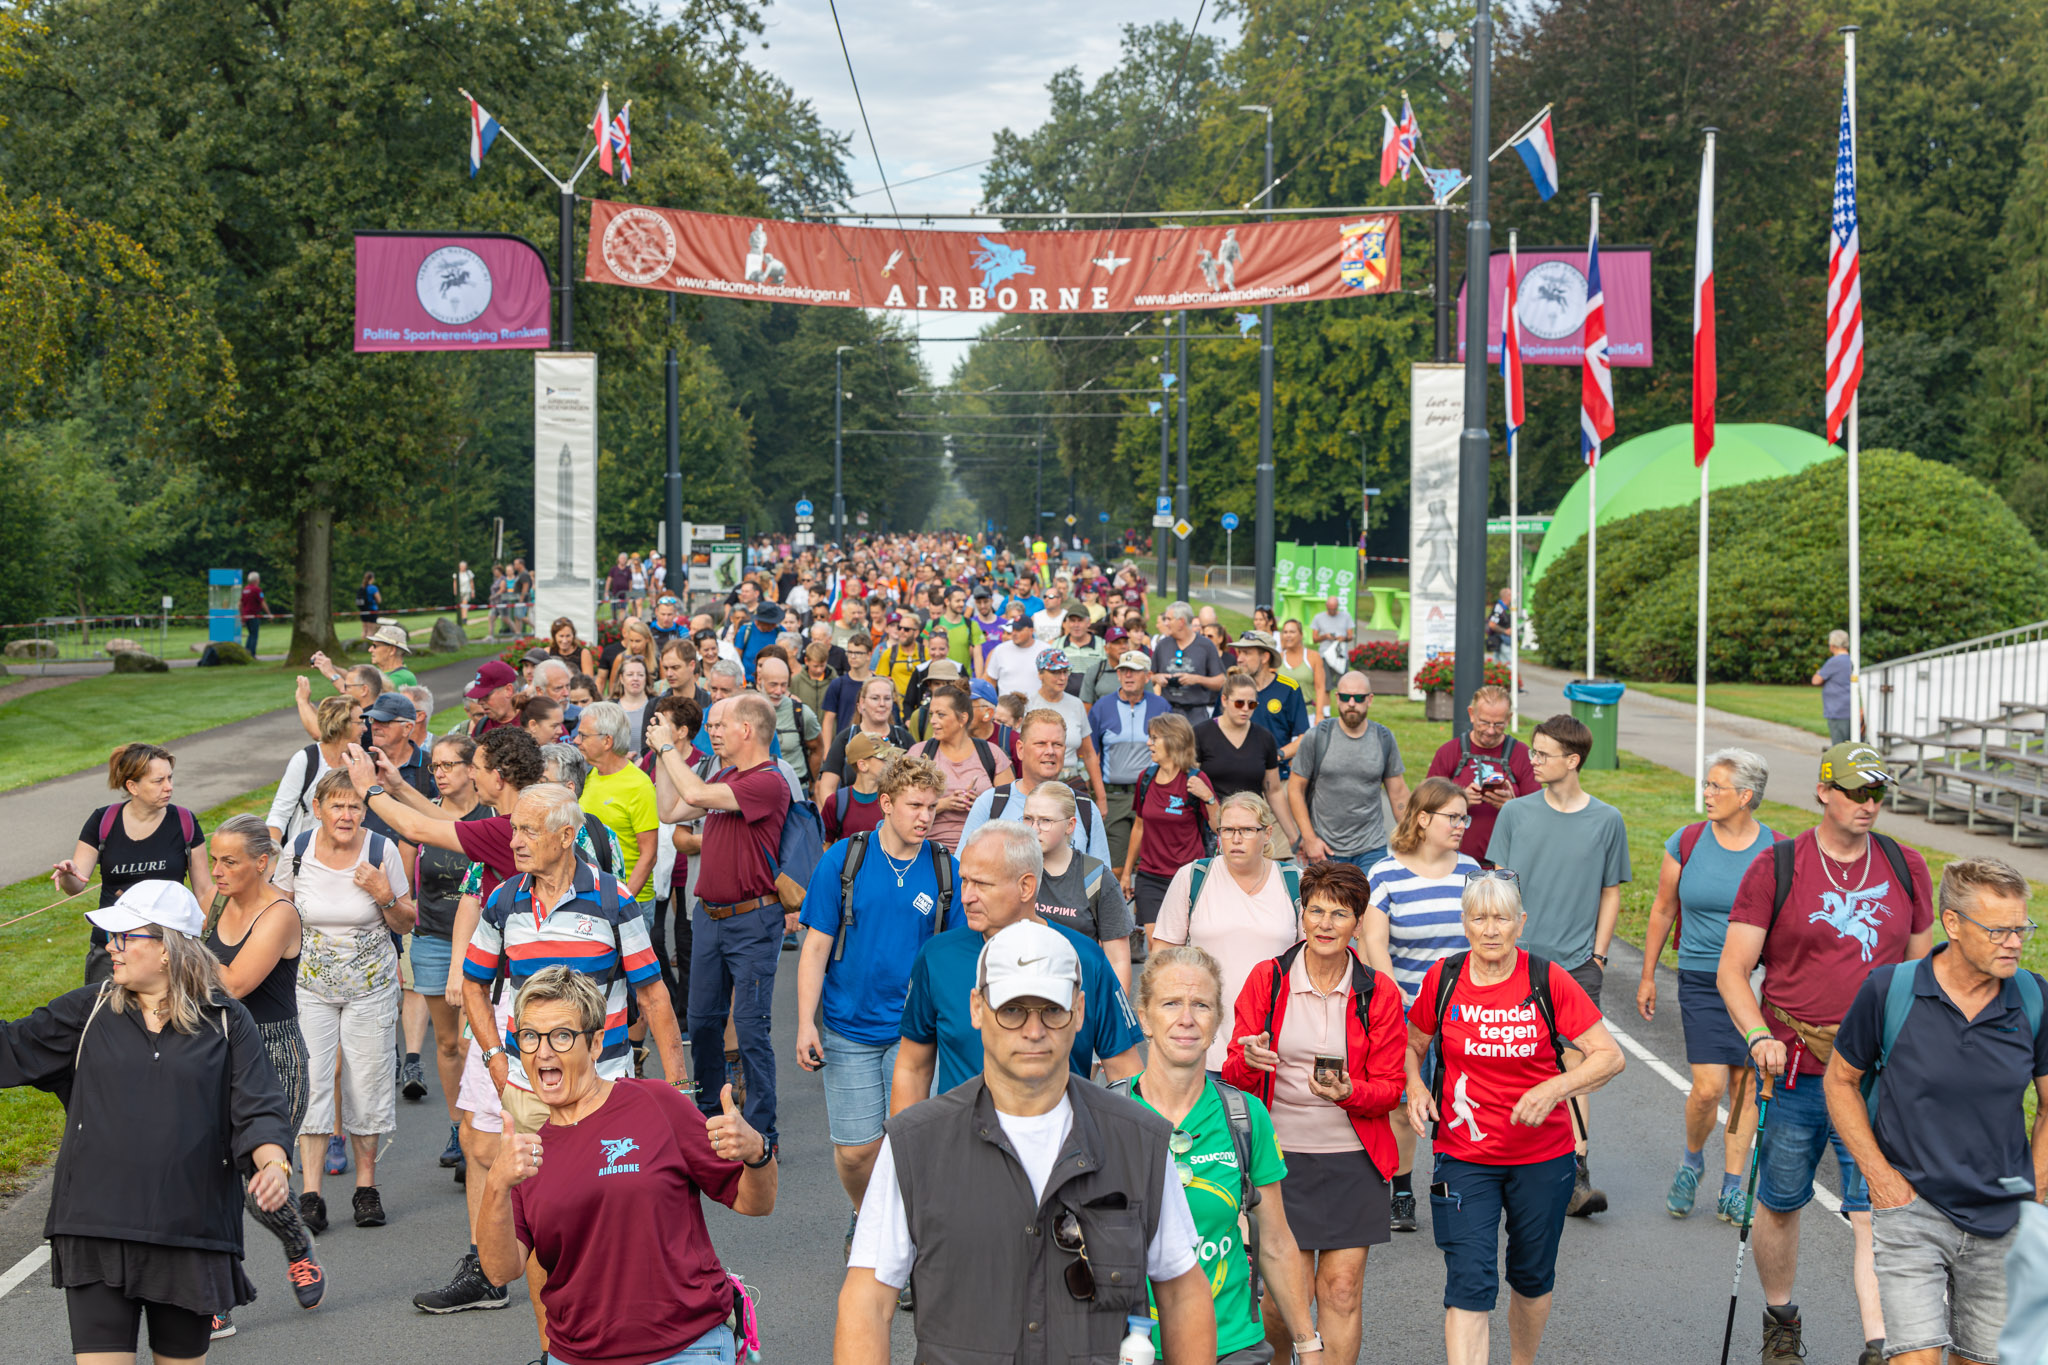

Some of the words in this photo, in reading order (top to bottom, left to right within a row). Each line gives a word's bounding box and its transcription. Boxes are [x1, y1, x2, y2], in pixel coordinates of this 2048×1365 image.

[883, 284, 1110, 310] AIRBORNE
[1134, 282, 1310, 306] www.airbornewandeltocht.nl
[363, 328, 400, 340] Politie
[403, 329, 498, 343] Sportvereniging
[501, 326, 548, 340] Renkum
[111, 860, 166, 874] ALLURE
[1451, 1004, 1536, 1023] #Wandel
[1479, 1023, 1537, 1043] tegen
[1464, 1038, 1538, 1057] kanker
[1190, 1151, 1235, 1165] saucony
[598, 1164, 640, 1176] AIRBORNE
